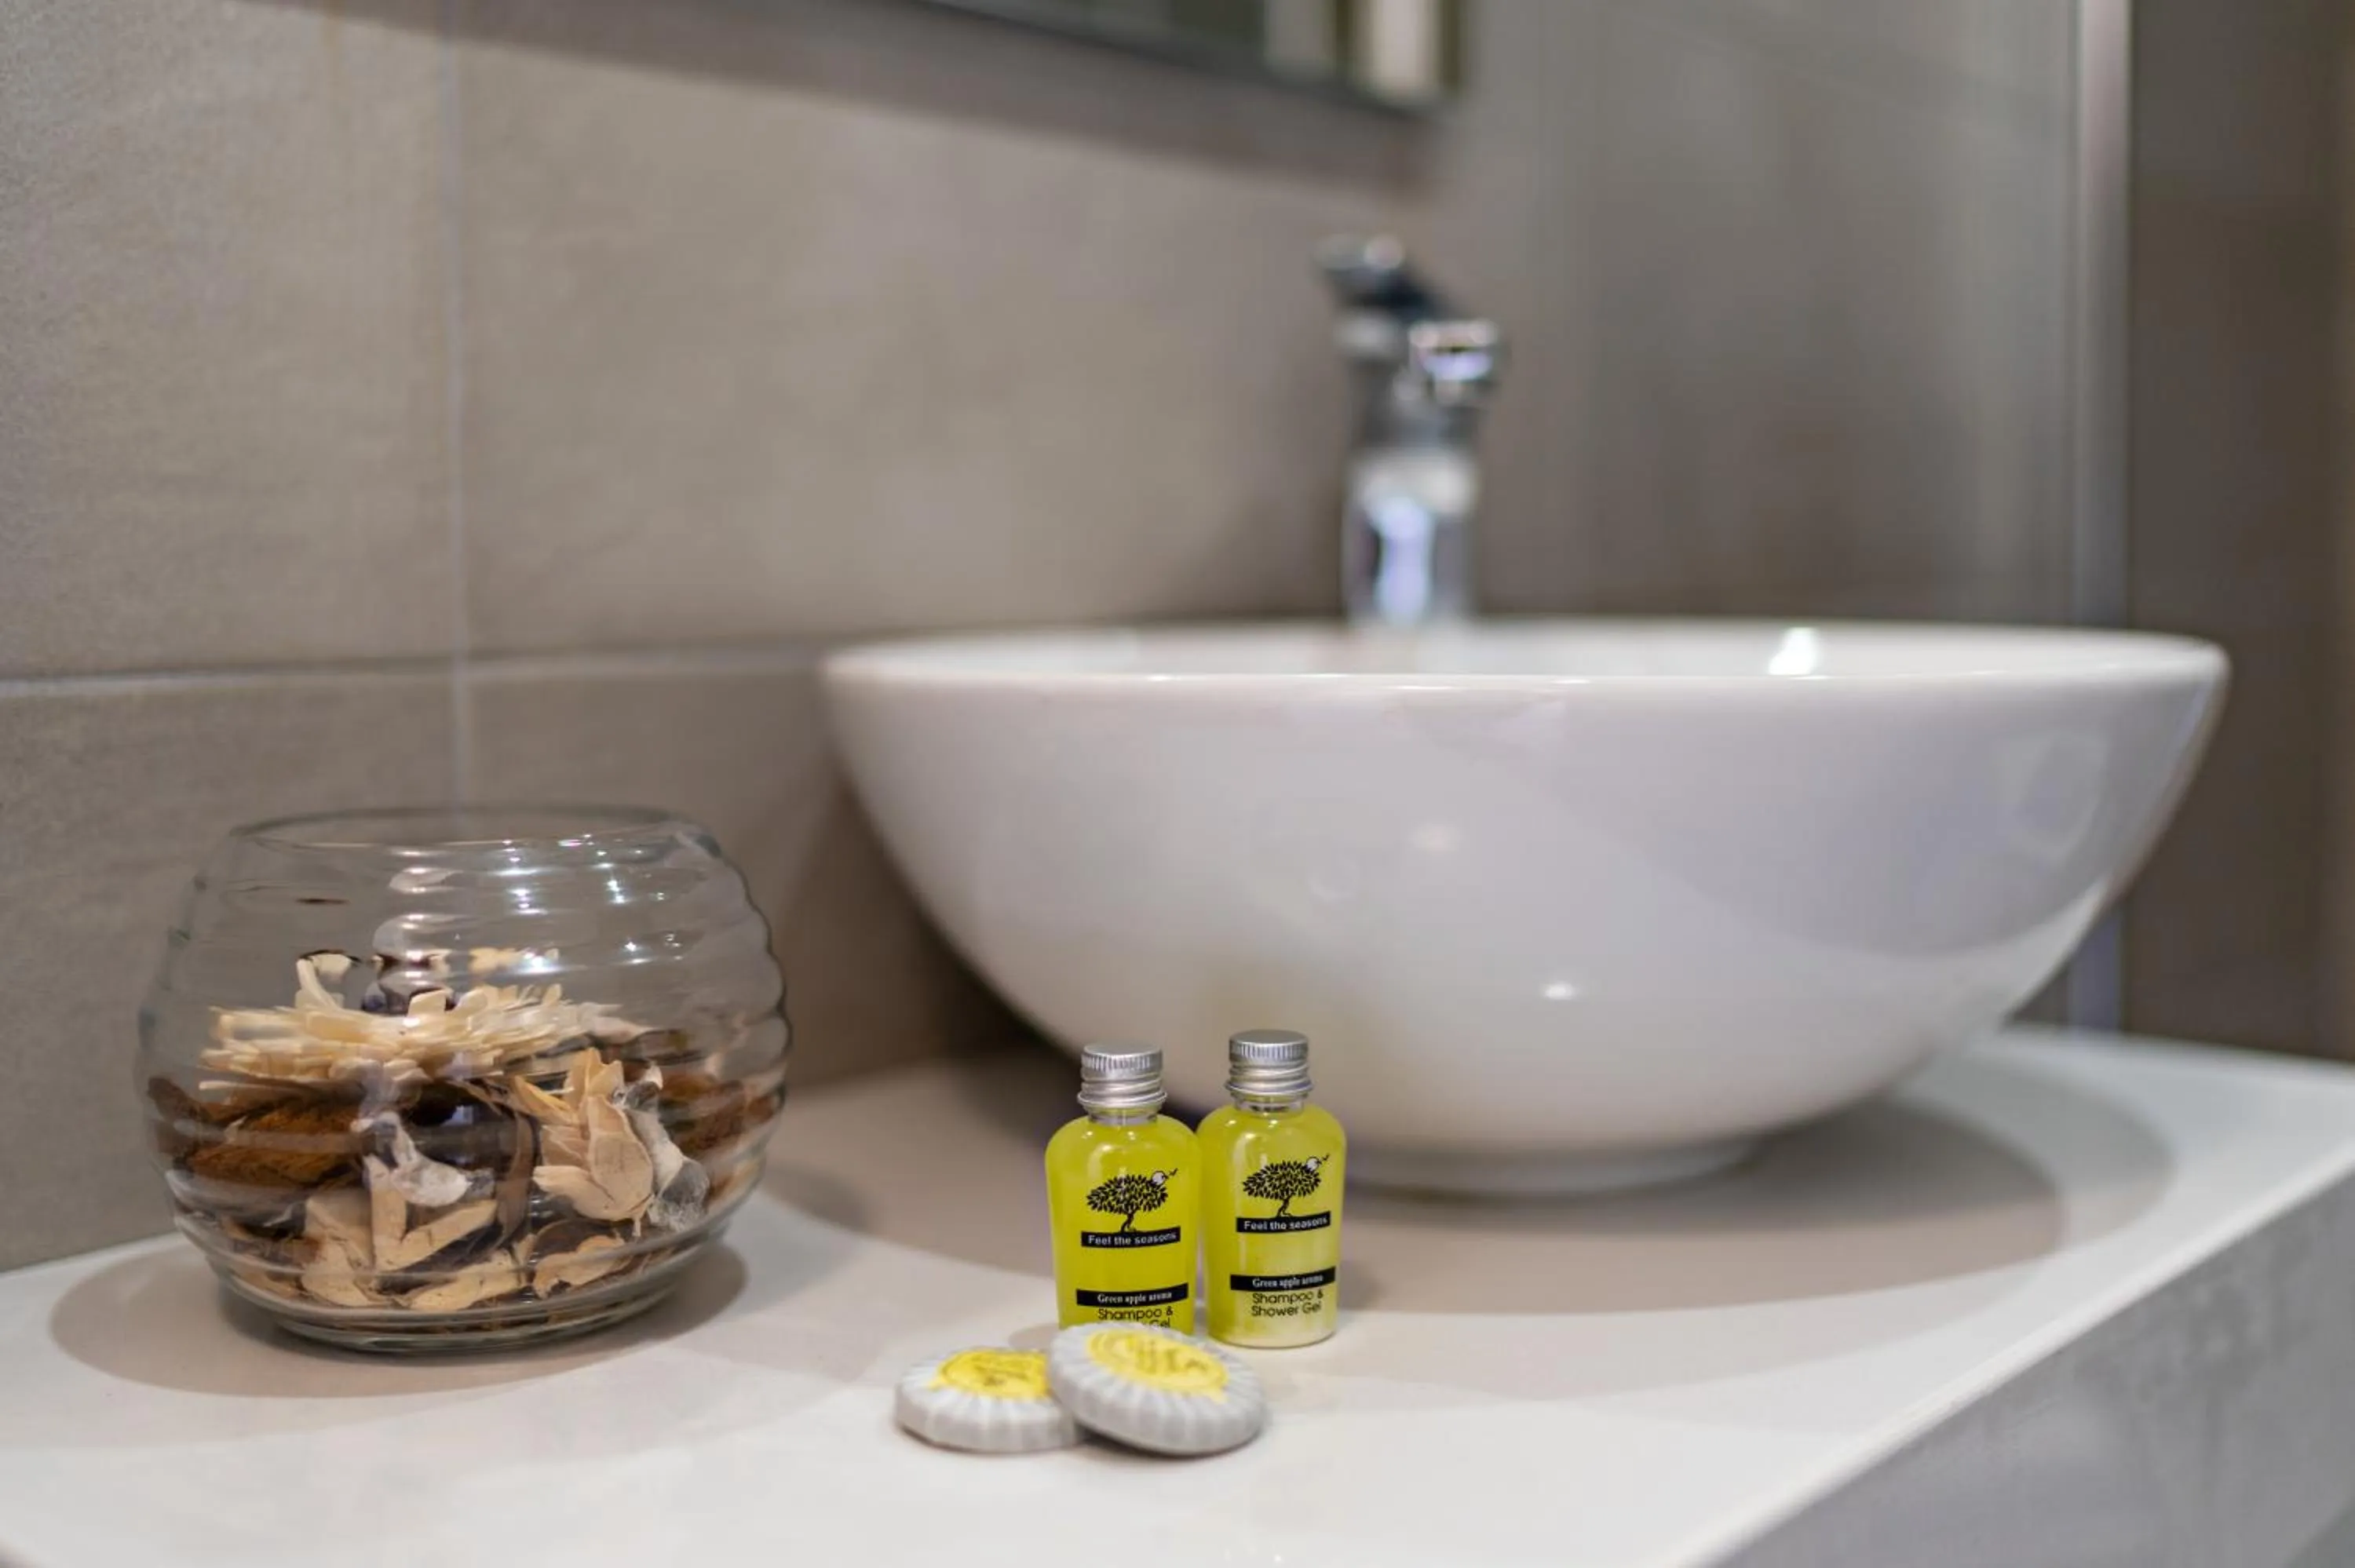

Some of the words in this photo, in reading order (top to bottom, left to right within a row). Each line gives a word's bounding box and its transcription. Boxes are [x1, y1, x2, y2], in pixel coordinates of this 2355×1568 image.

[1244, 1220, 1268, 1230] Feel
[1270, 1220, 1287, 1230] the
[1290, 1216, 1328, 1228] seasons
[1088, 1234, 1112, 1245] Feel
[1114, 1234, 1131, 1245] the
[1134, 1232, 1177, 1244] seasons
[1252, 1278, 1277, 1288] Green
[1280, 1277, 1300, 1289] apple
[1097, 1294, 1123, 1304] Green
[1125, 1293, 1146, 1306] apple
[1252, 1292, 1313, 1304] Shampoo
[1098, 1308, 1162, 1322] Shampoo
[1166, 1306, 1174, 1316] &
[1251, 1305, 1299, 1317] Shower
[1302, 1301, 1322, 1314] Gel
